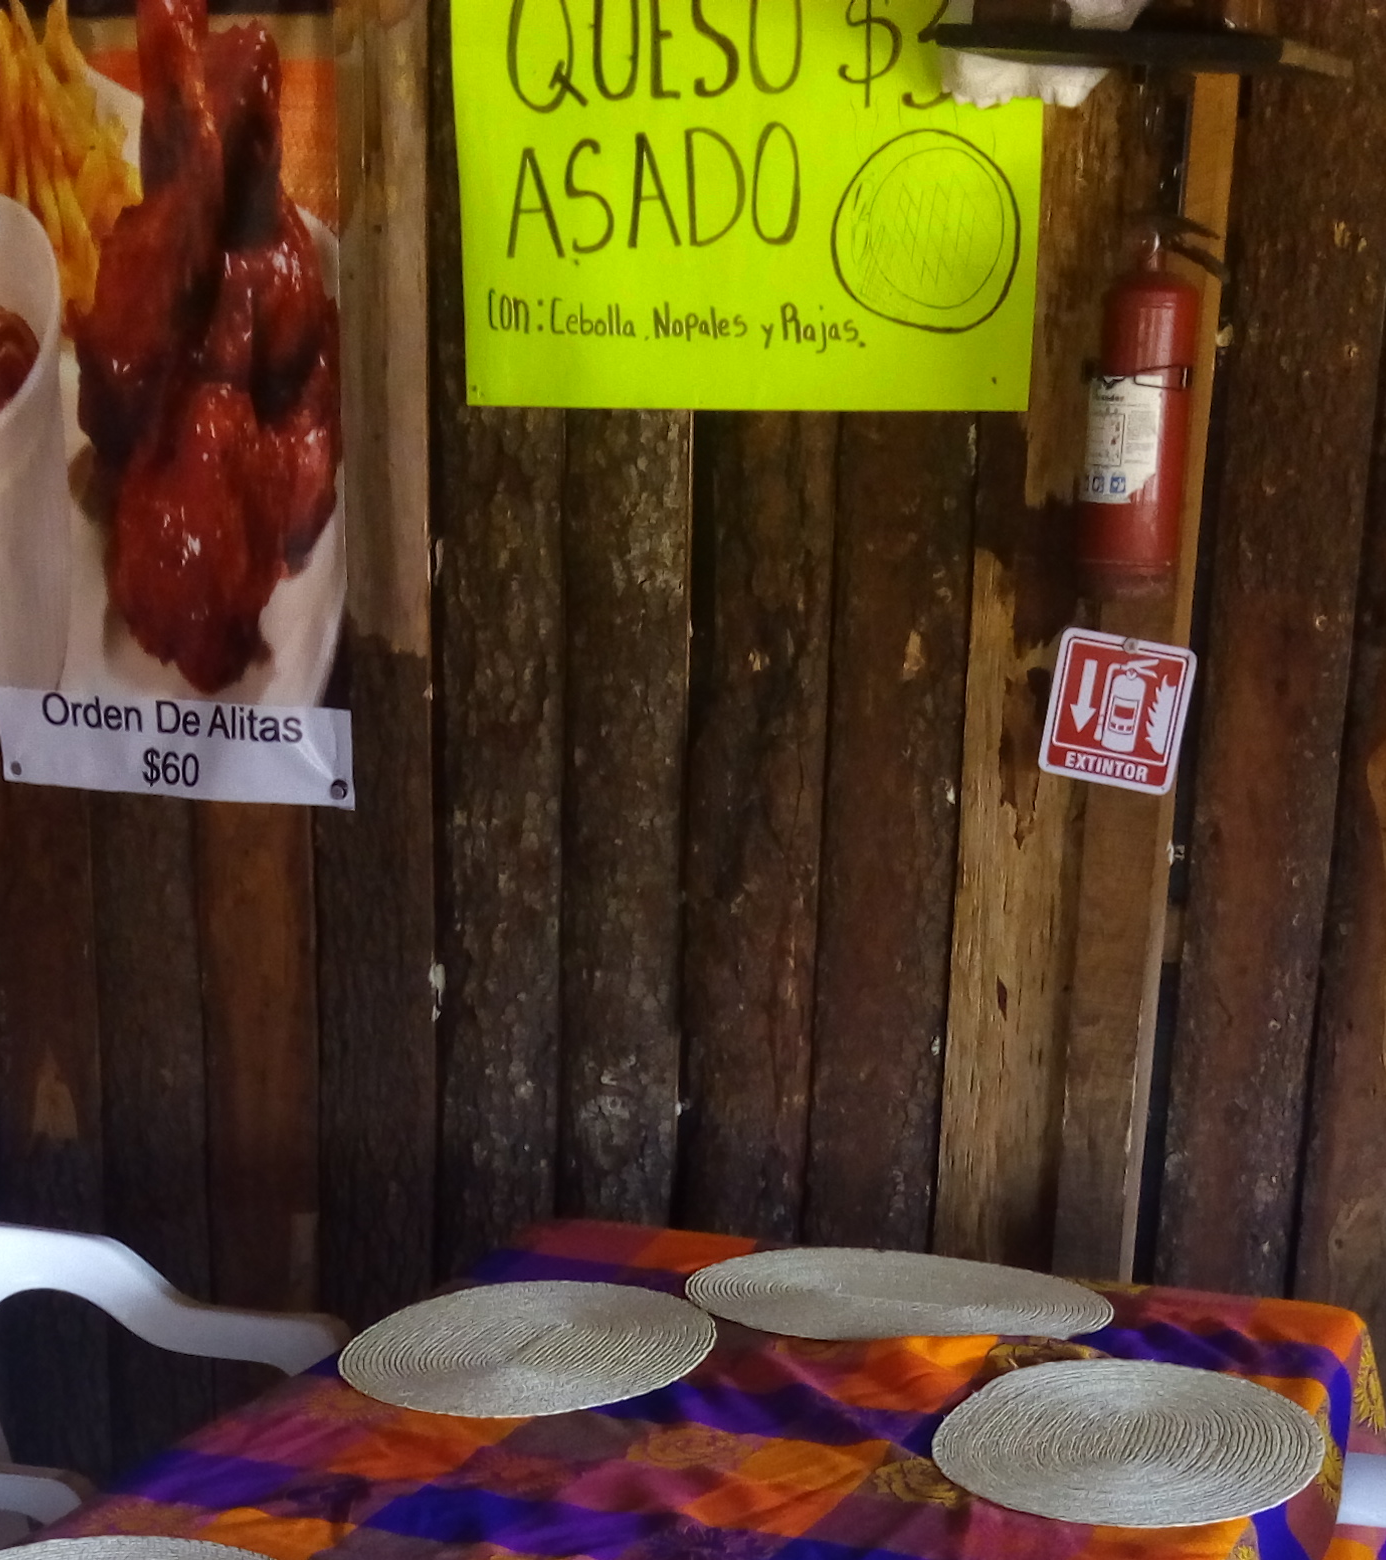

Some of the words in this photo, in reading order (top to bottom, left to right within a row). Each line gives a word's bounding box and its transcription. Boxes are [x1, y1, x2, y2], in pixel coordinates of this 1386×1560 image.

[507, 0, 803, 113] QUESO
[506, 121, 801, 260] ASADO
[652, 300, 748, 342] Nopales
[760, 322, 775, 349] y
[41, 691, 143, 733] Orden
[155, 700, 201, 738] De
[207, 705, 304, 744] Alitas
[142, 746, 201, 789] $60
[1064, 750, 1150, 783] EXTINTOR
